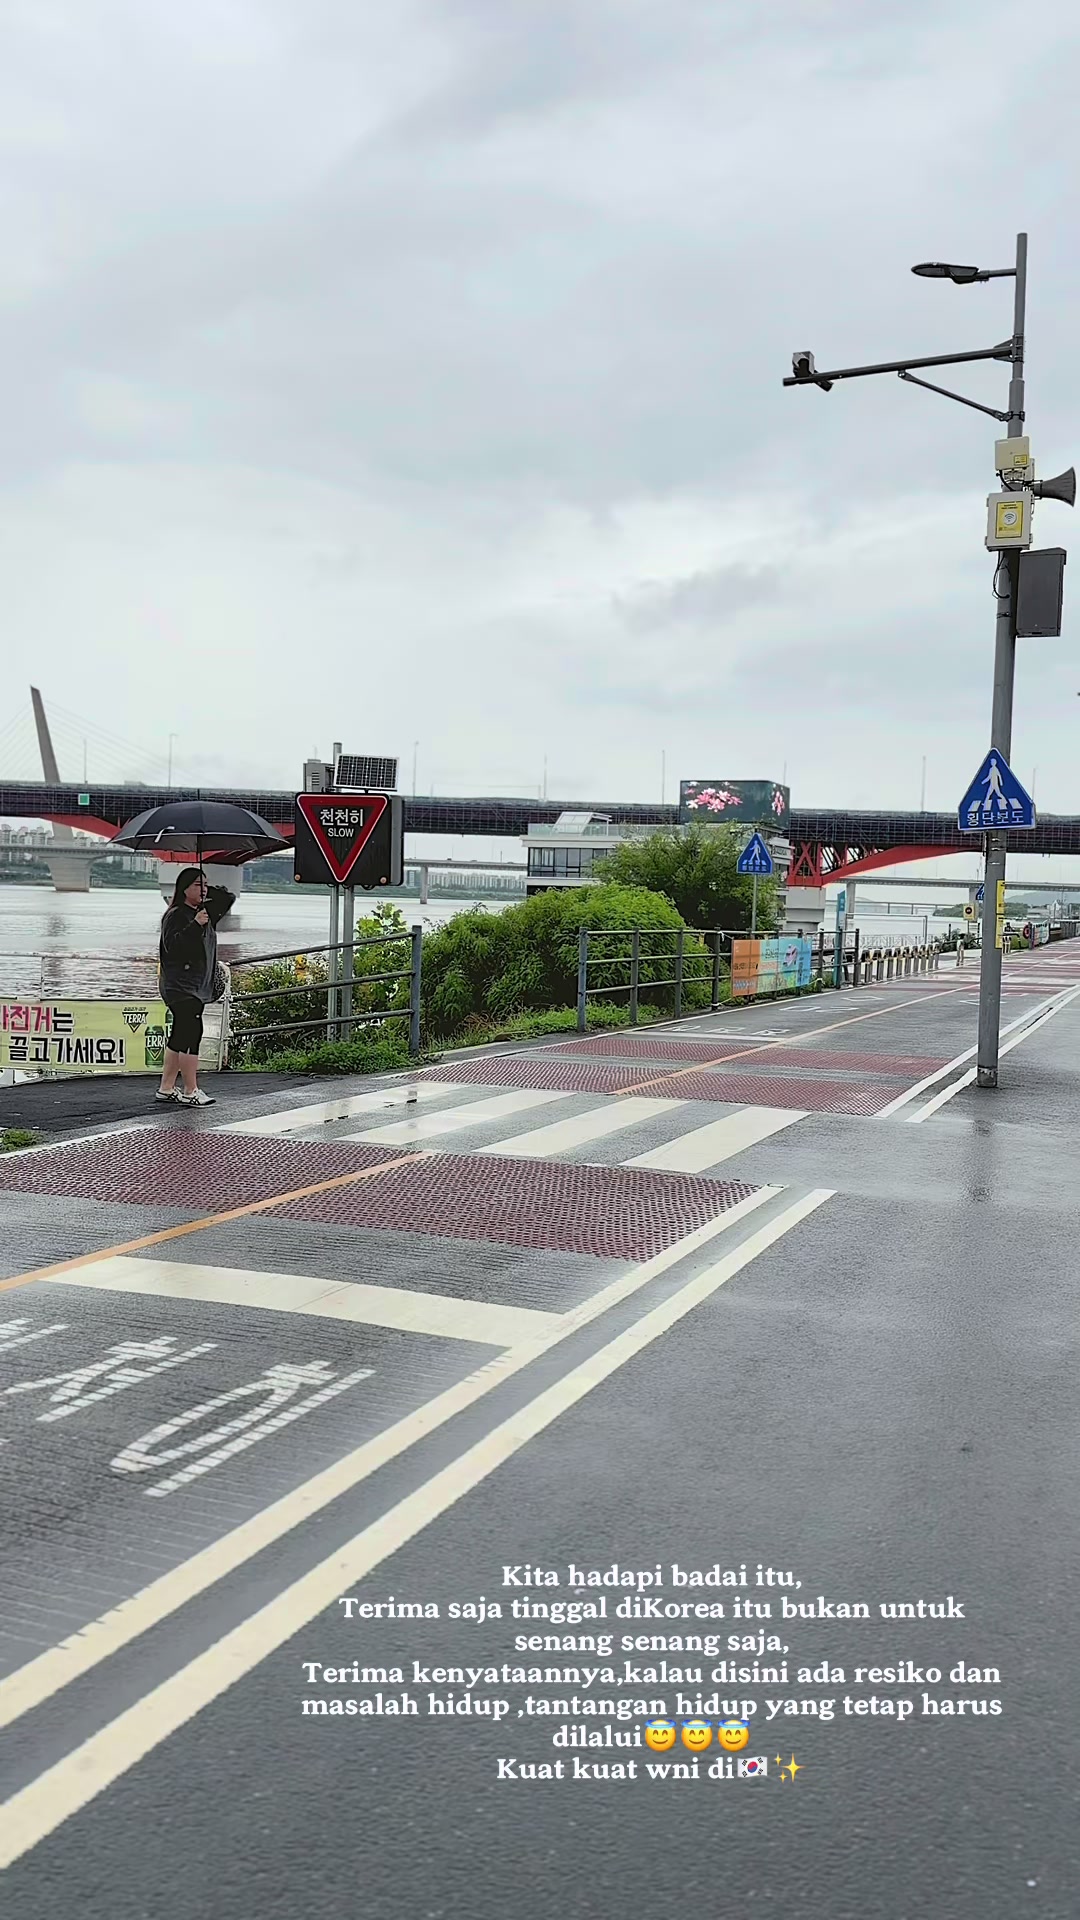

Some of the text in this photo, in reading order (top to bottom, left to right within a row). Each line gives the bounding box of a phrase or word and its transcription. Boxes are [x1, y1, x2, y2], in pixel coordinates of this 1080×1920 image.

[319, 808, 364, 827] 천천히
[966, 810, 1024, 827] 횡단보도
[327, 828, 355, 838] SLOW
[123, 1013, 148, 1025] TERRA
[9, 1036, 125, 1065] 끌고가세요!
